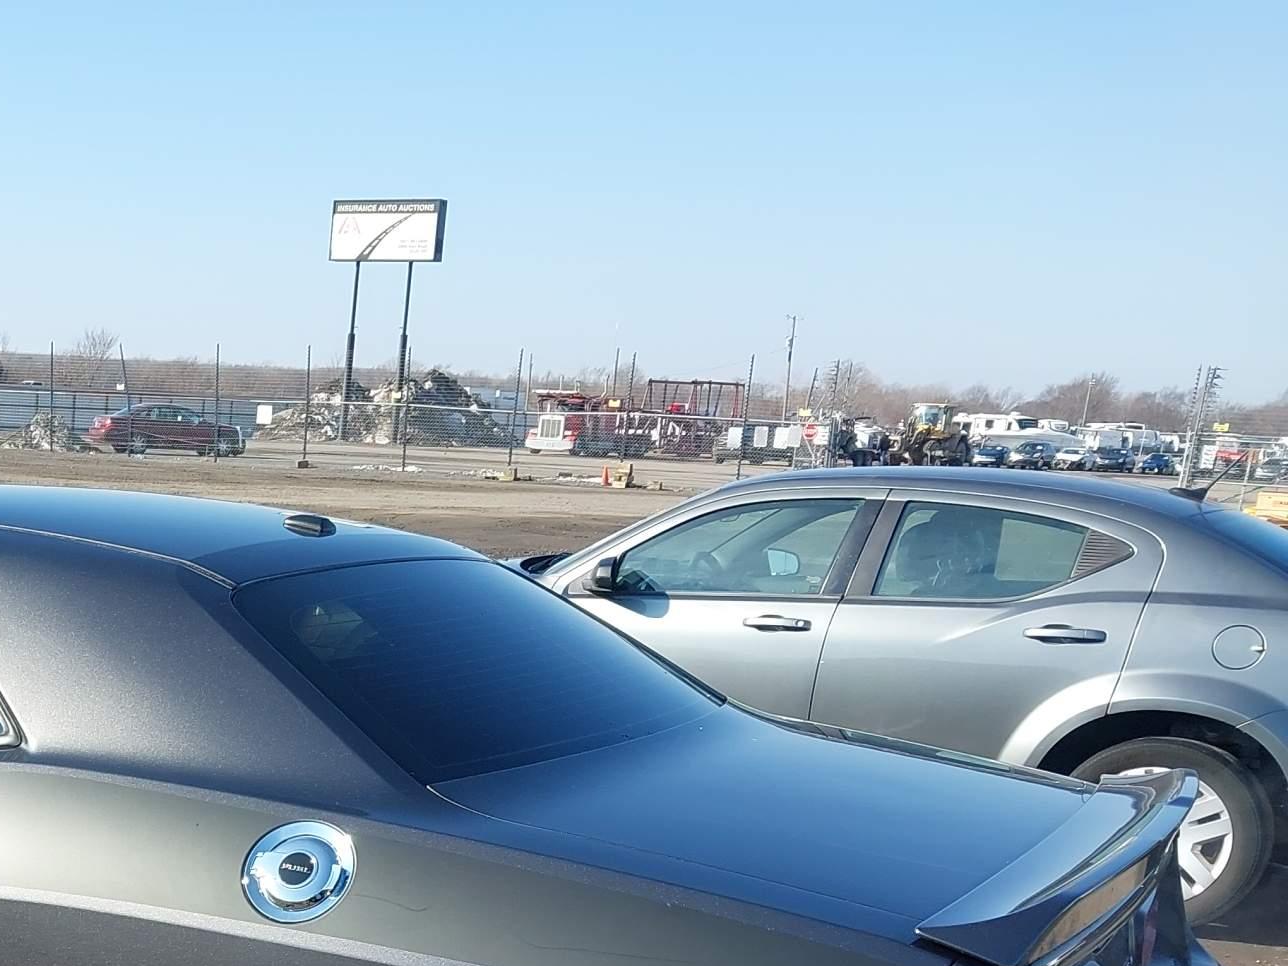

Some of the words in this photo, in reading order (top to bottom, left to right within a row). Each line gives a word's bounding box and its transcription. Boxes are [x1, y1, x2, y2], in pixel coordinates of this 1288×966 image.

[337, 204, 377, 212] INSURANCE
[378, 204, 397, 212] AUTO
[398, 203, 435, 212] AUCTIONS
